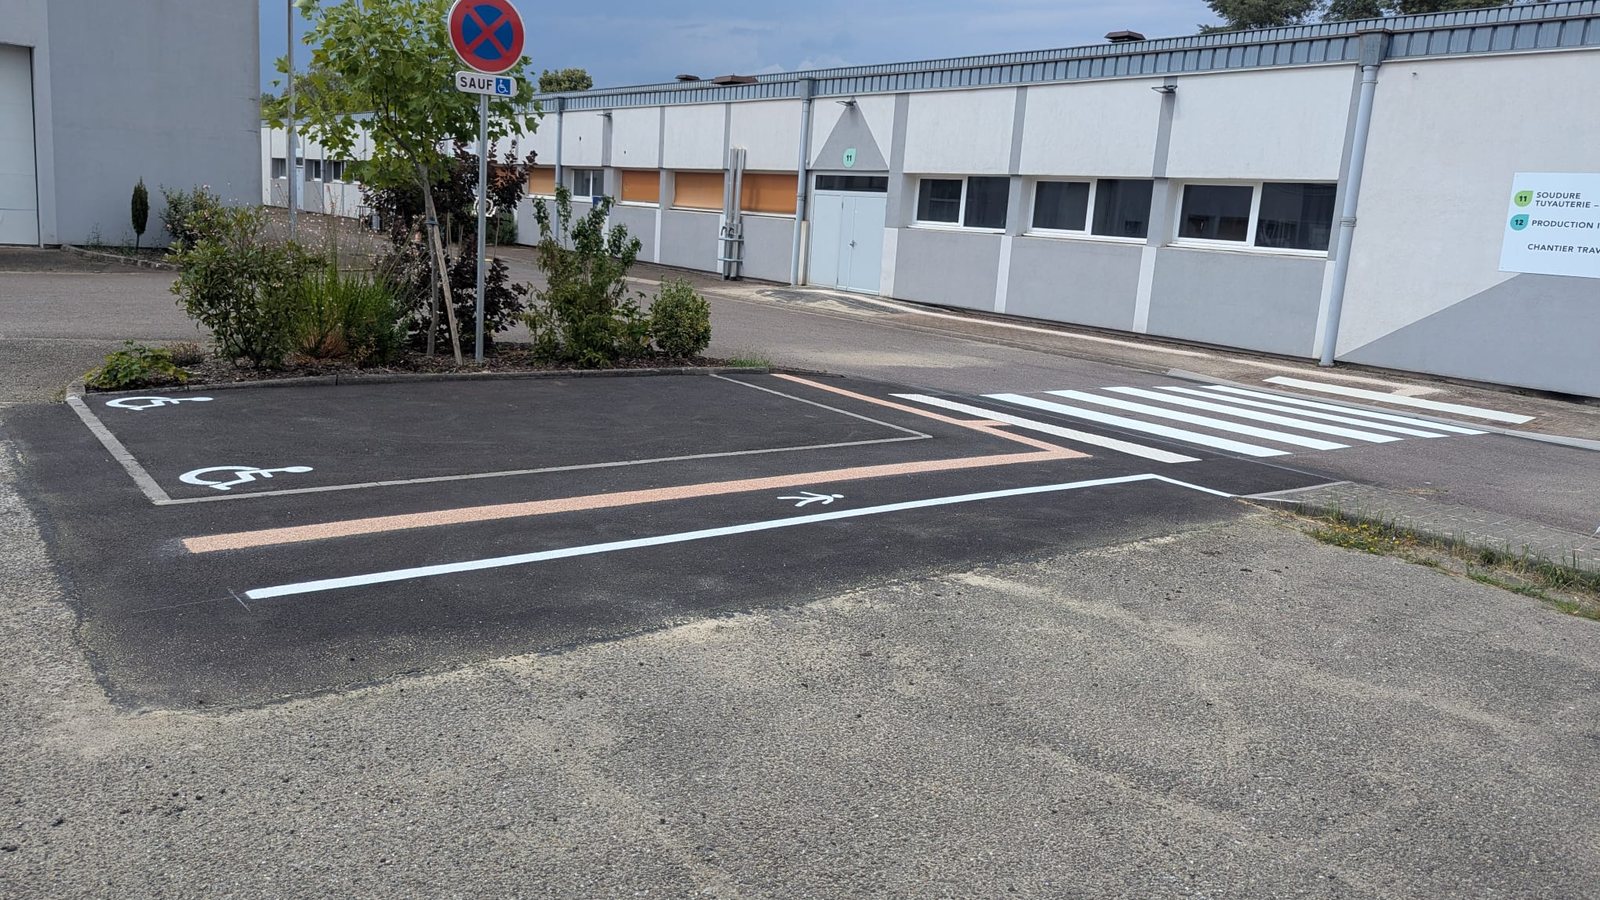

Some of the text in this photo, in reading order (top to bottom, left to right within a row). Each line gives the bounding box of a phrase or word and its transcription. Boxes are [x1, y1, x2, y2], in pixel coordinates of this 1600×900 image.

[460, 76, 493, 90] SAUF
[846, 154, 853, 162] 11
[1536, 191, 1581, 200] SOUDURE
[1535, 200, 1592, 208] TUYAUTERIE
[1531, 219, 1594, 229] PRODUCTION
[1527, 243, 1574, 253] CHANTIER
